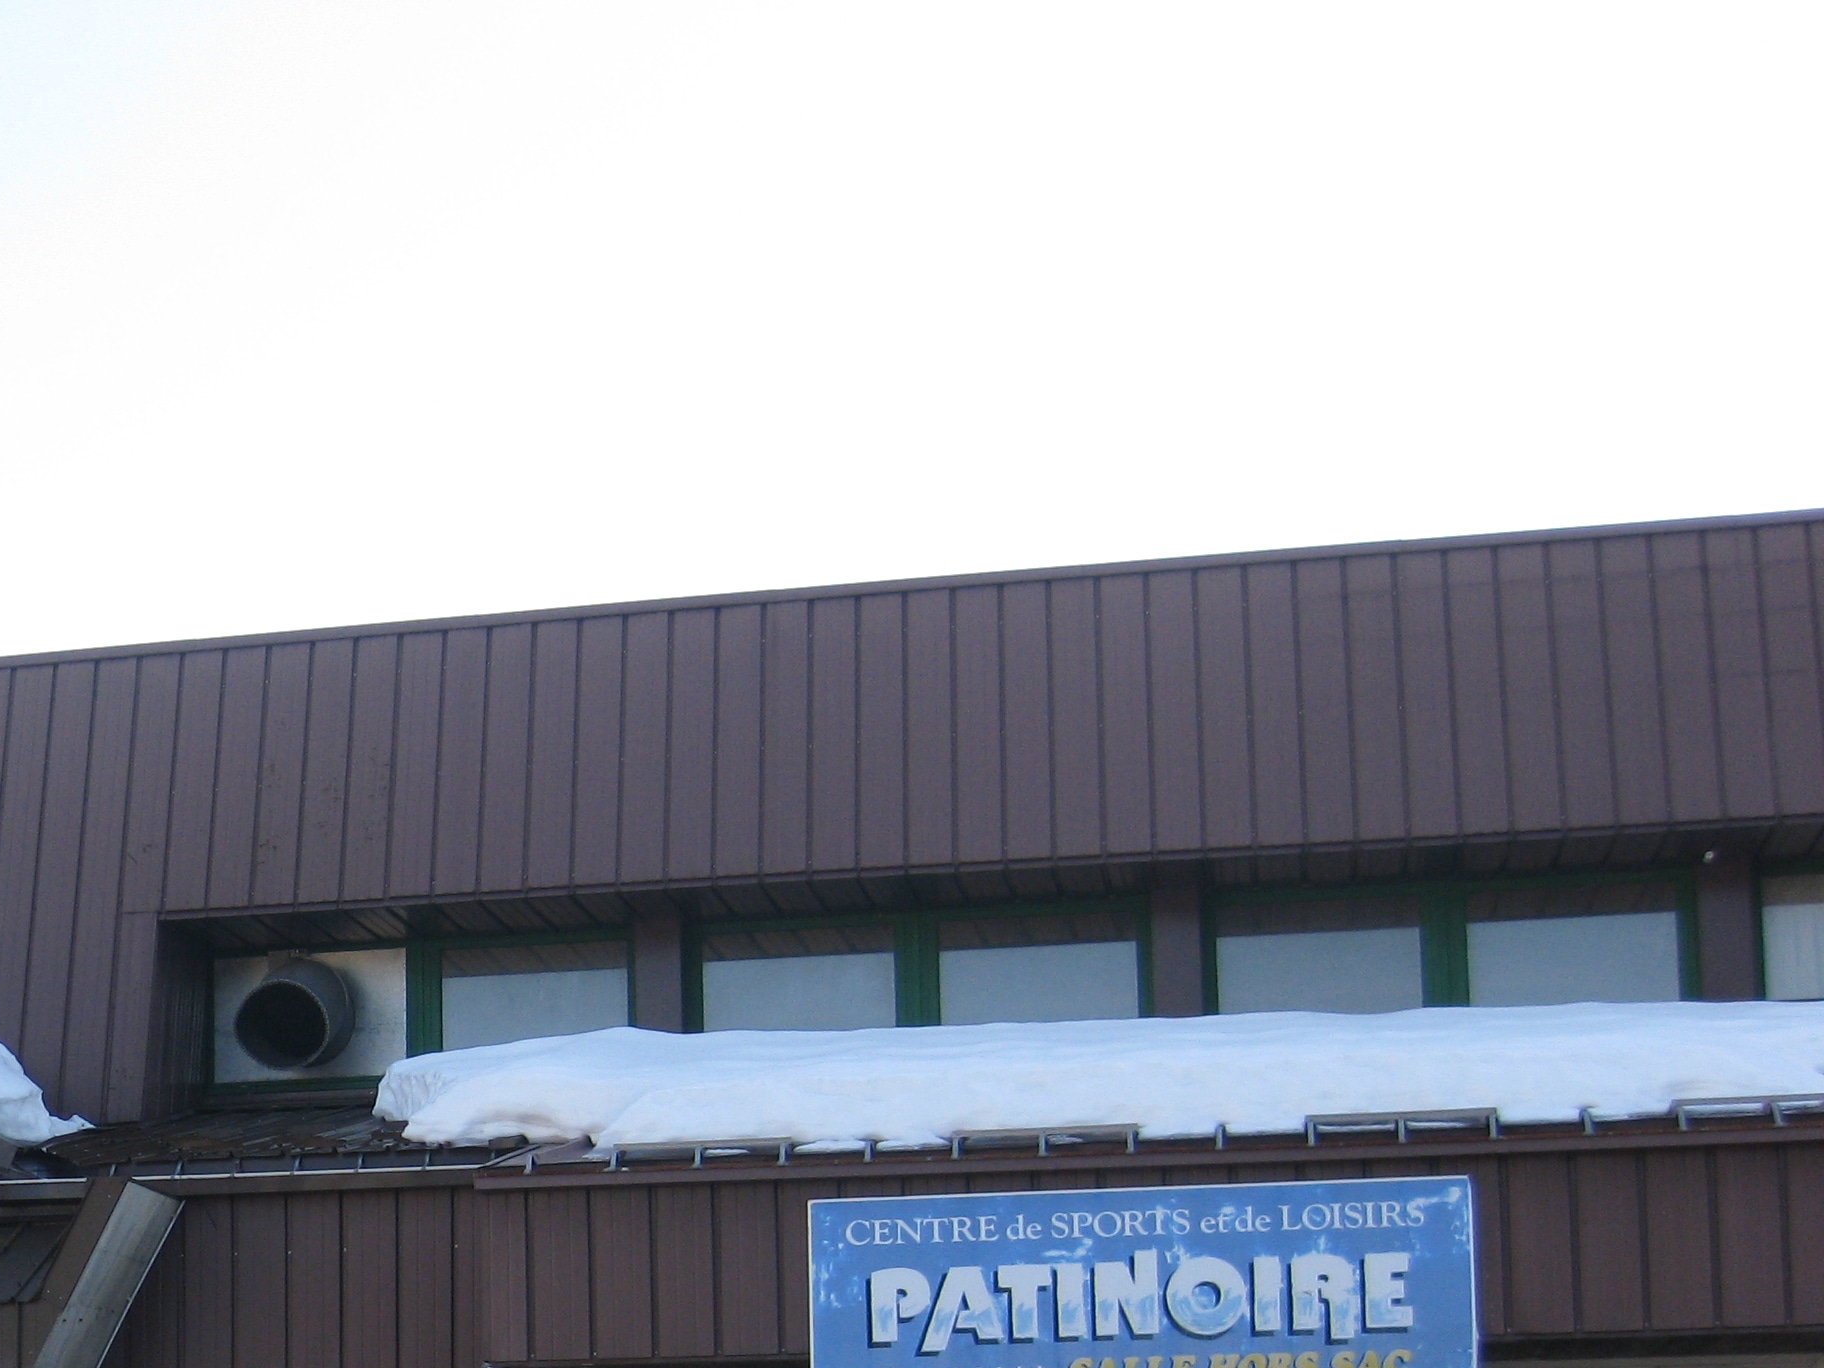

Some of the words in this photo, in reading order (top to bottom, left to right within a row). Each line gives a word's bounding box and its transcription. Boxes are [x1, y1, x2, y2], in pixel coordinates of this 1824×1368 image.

[845, 1216, 998, 1247] CENTRE
[1006, 1213, 1041, 1241] de
[1051, 1209, 1190, 1239] SPORTS
[1280, 1201, 1425, 1231] LOISIRS
[867, 1250, 1413, 1355] PATINOIRE
